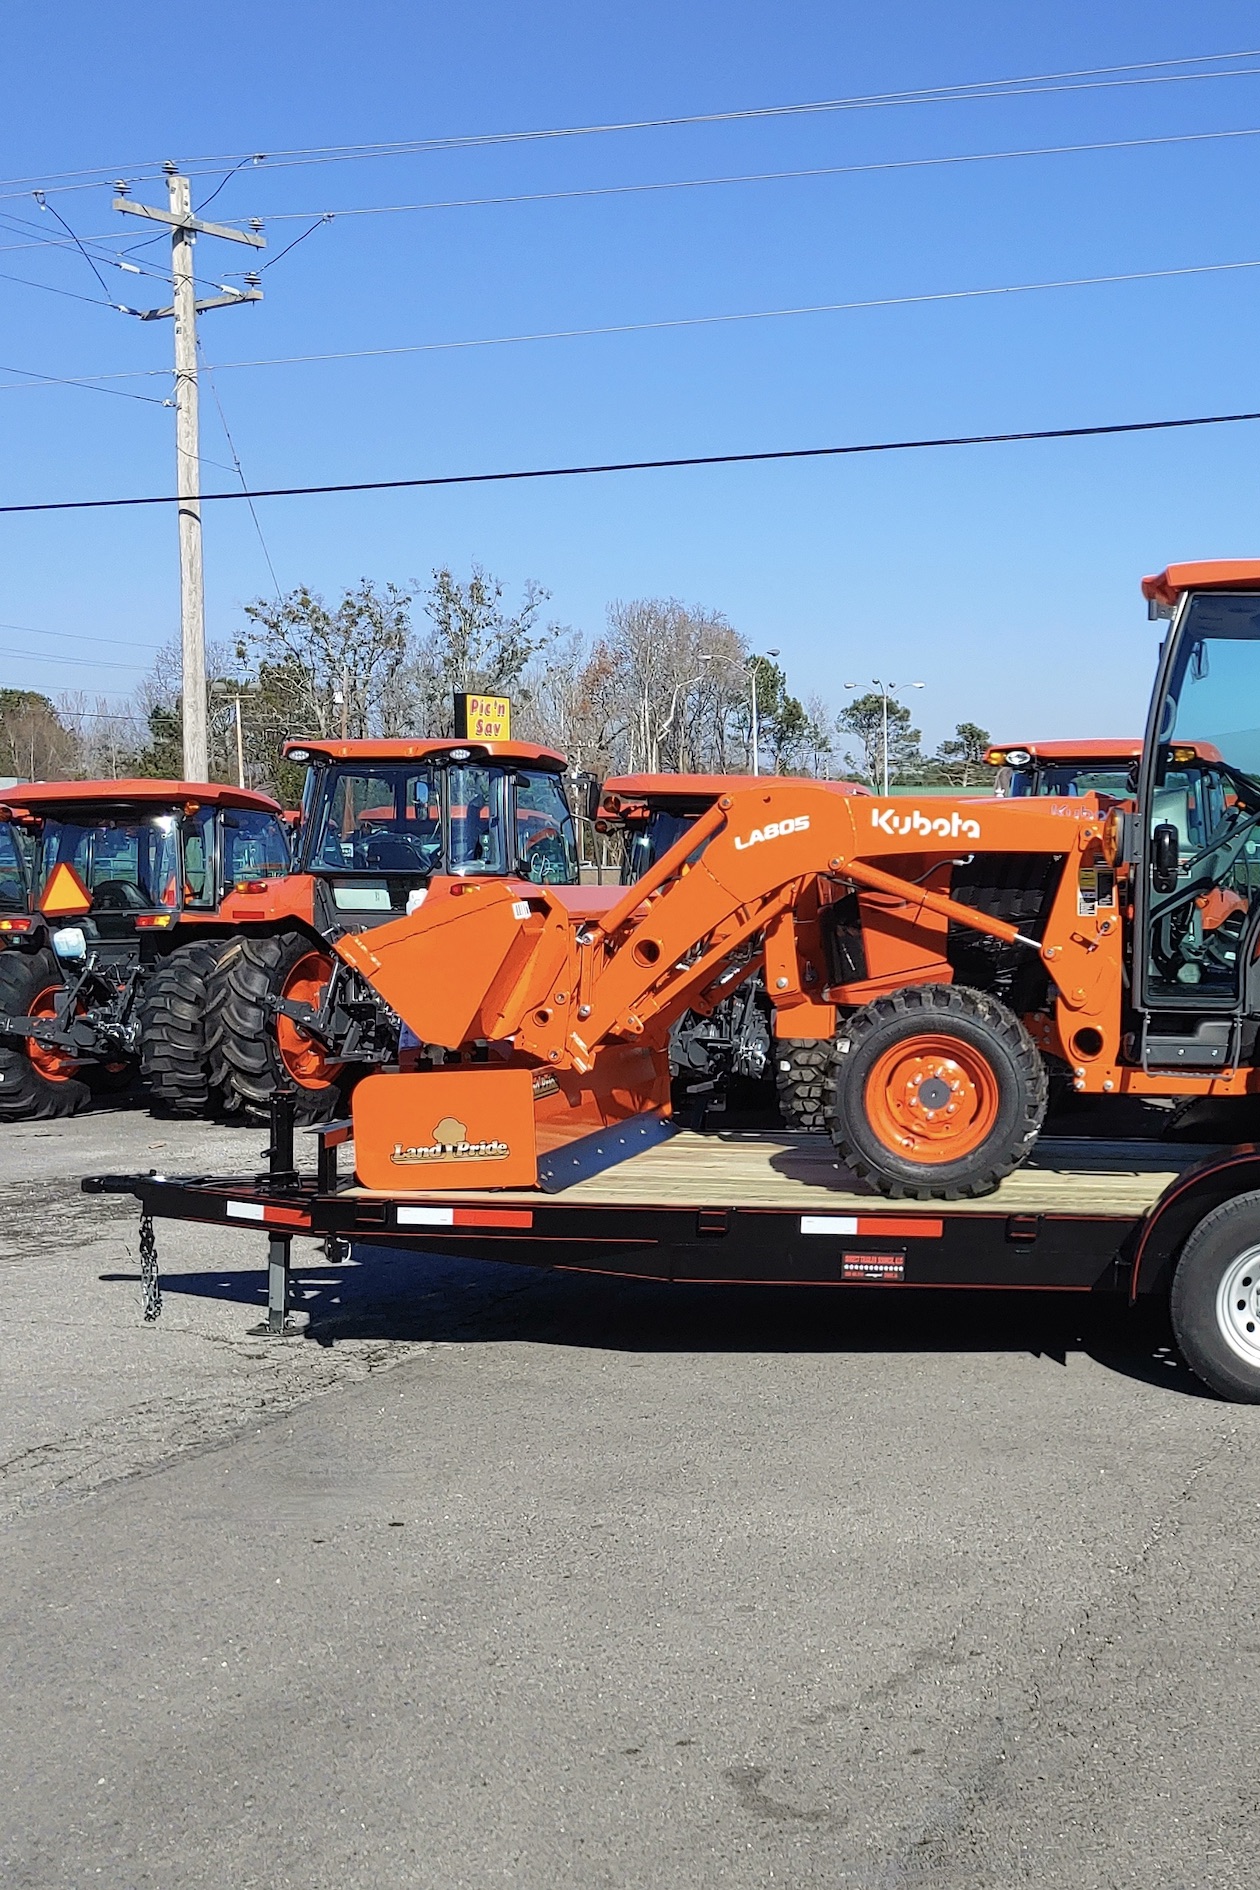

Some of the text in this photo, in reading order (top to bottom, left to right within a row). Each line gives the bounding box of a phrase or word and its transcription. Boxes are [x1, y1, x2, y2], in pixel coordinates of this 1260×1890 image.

[470, 699, 491, 716] Pic
[475, 719, 501, 736] Sav
[734, 815, 810, 850] LA805
[871, 808, 981, 839] Kubota
[393, 1140, 509, 1160] Land Pride
